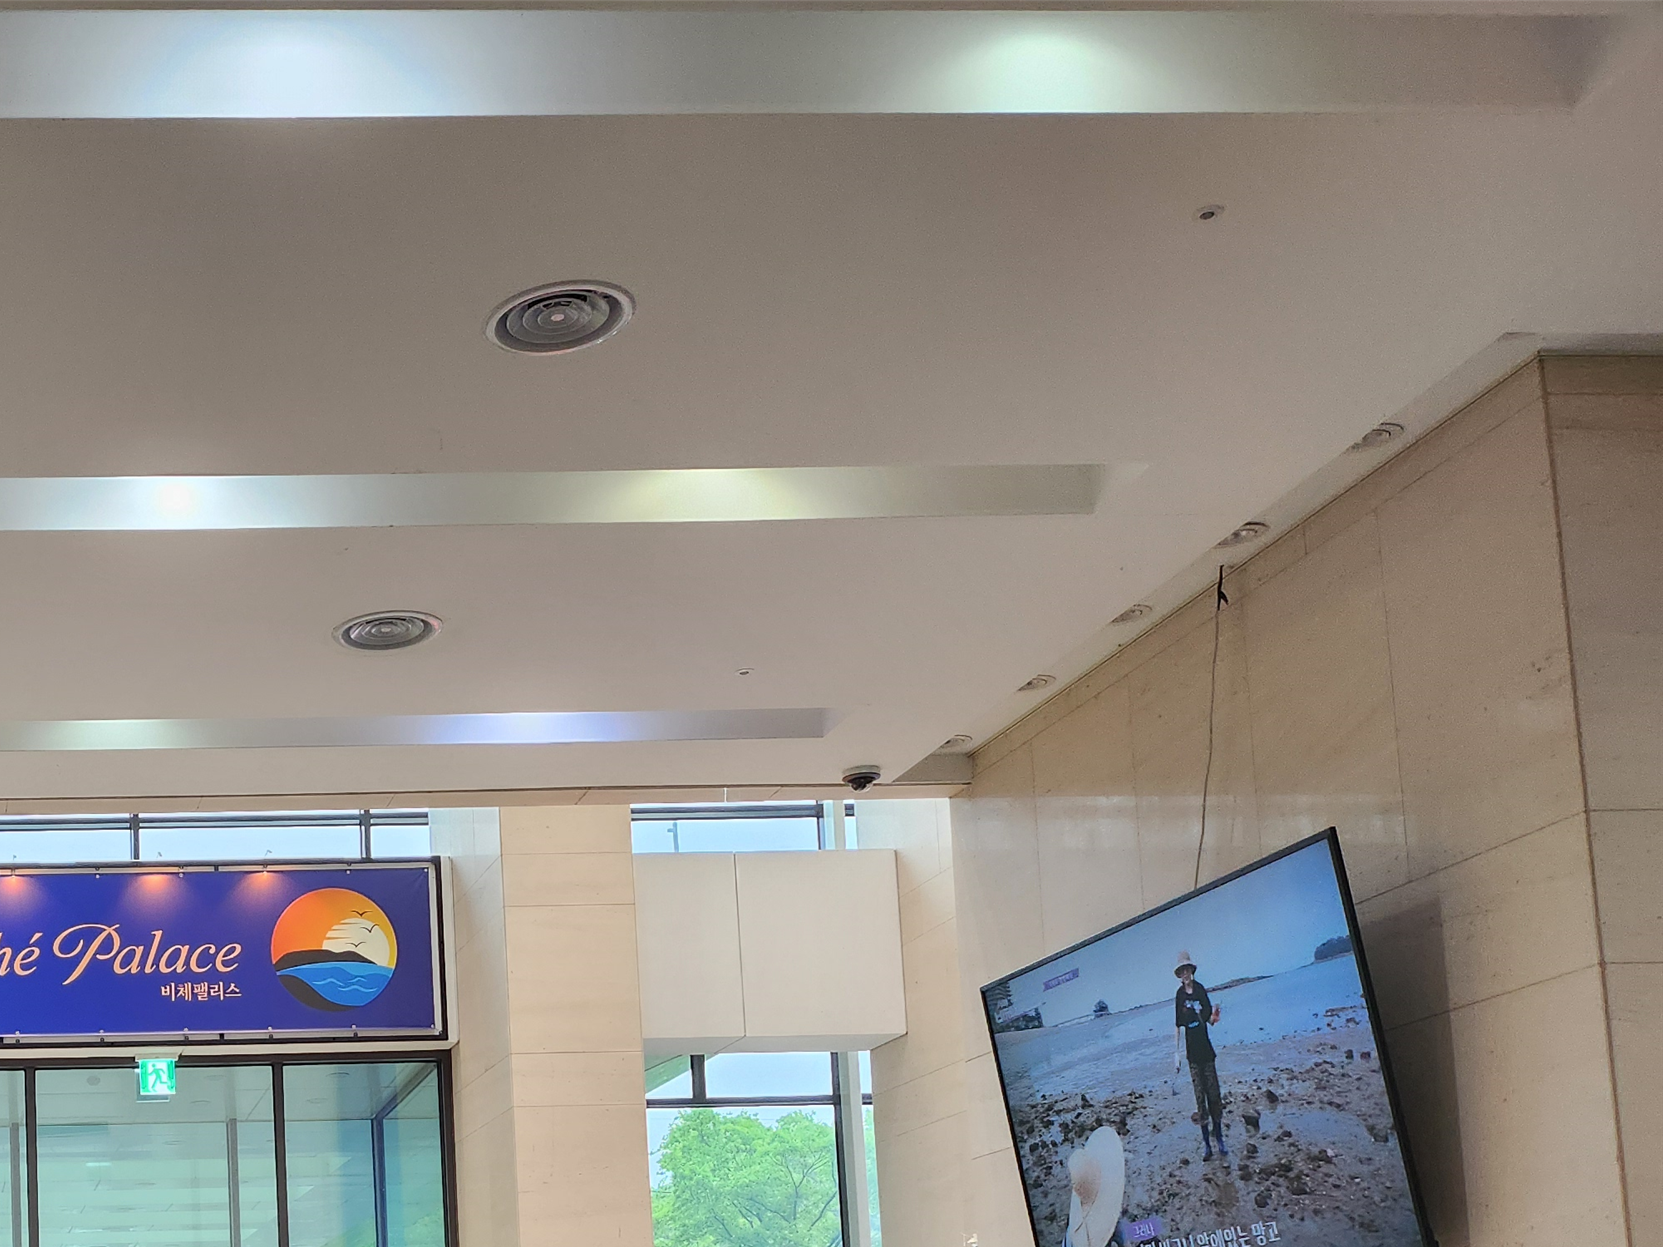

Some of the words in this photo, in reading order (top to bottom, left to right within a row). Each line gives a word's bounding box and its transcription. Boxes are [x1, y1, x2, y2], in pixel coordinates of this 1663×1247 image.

[52, 923, 242, 986] Palace
[160, 981, 243, 1001] 비체팰리스
[1250, 1220, 1282, 1247] 망고
